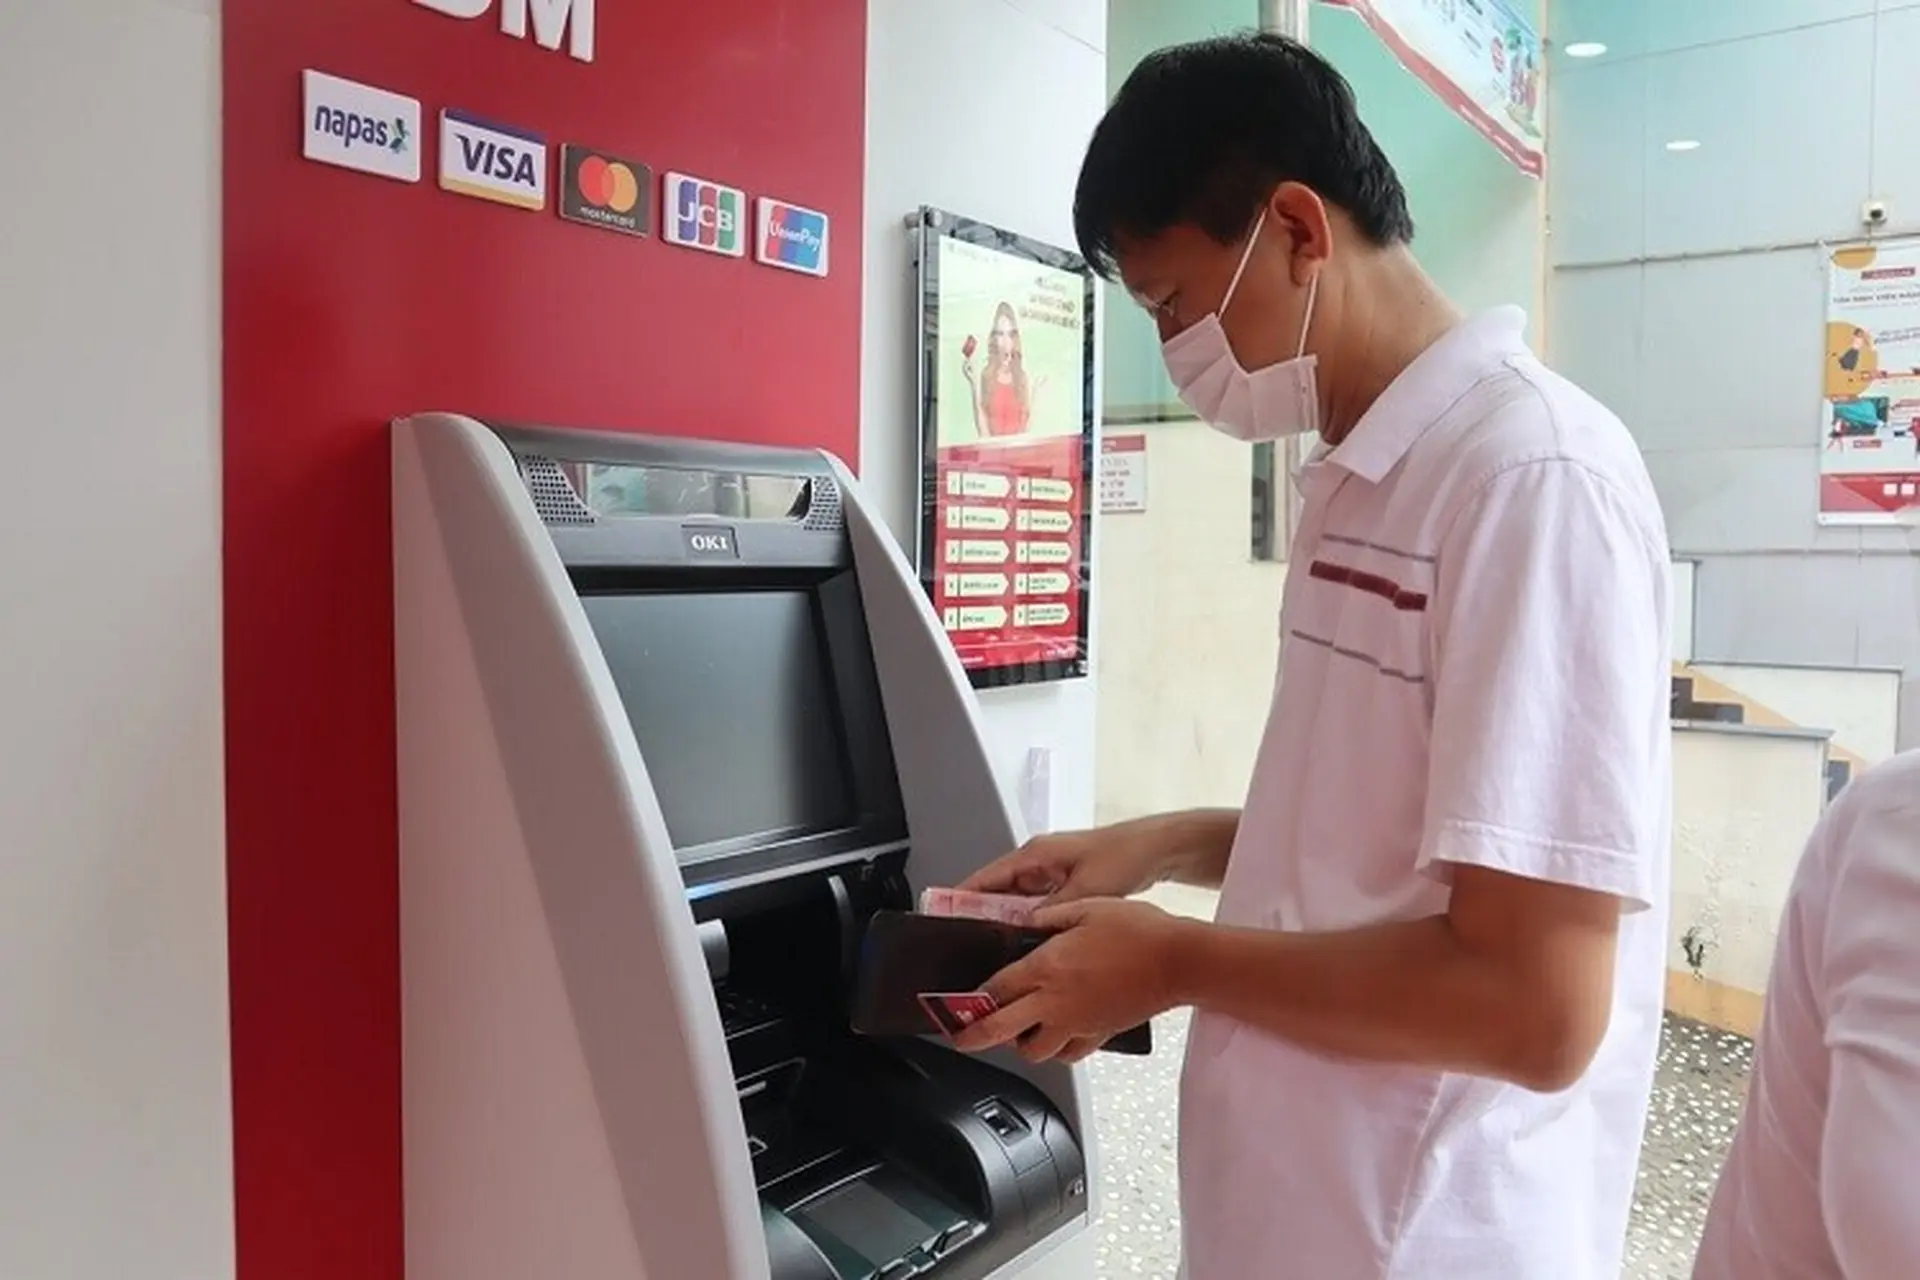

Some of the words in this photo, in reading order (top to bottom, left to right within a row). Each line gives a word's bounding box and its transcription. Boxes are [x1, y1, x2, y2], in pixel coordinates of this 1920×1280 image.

[314, 105, 388, 148] napas
[454, 133, 537, 188] VISA
[580, 206, 636, 229] mastercard
[677, 202, 733, 232] JCB
[769, 221, 822, 252] UnionPay
[691, 534, 728, 551] OKI
